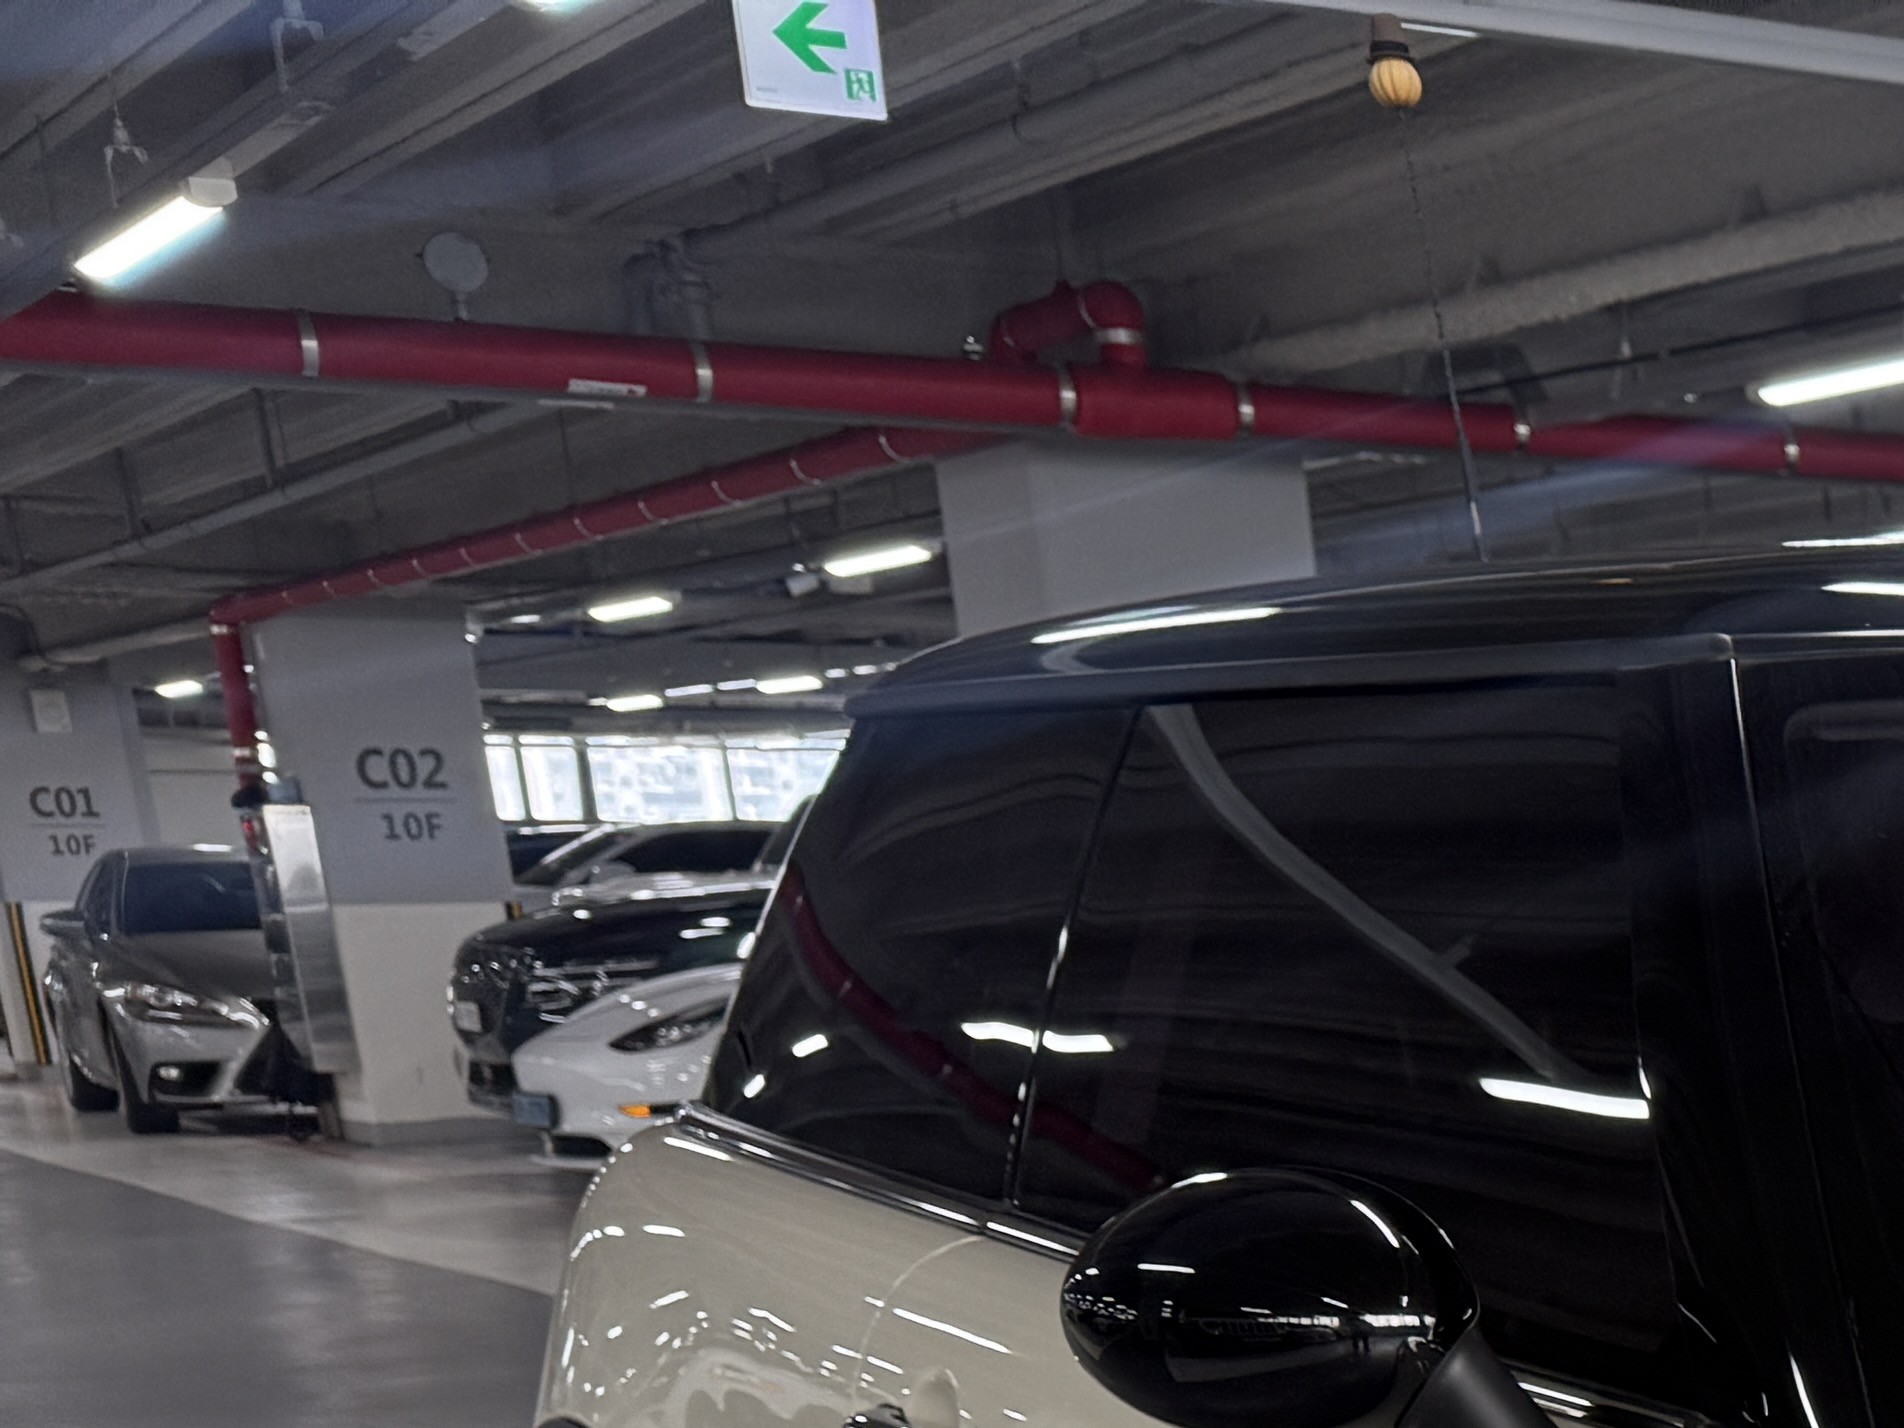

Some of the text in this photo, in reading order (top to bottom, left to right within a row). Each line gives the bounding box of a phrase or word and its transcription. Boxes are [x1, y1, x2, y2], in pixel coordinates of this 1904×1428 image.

[356, 747, 448, 790] C02
[29, 786, 100, 818] C01
[381, 811, 443, 841] 10F
[49, 834, 96, 856] 10F
